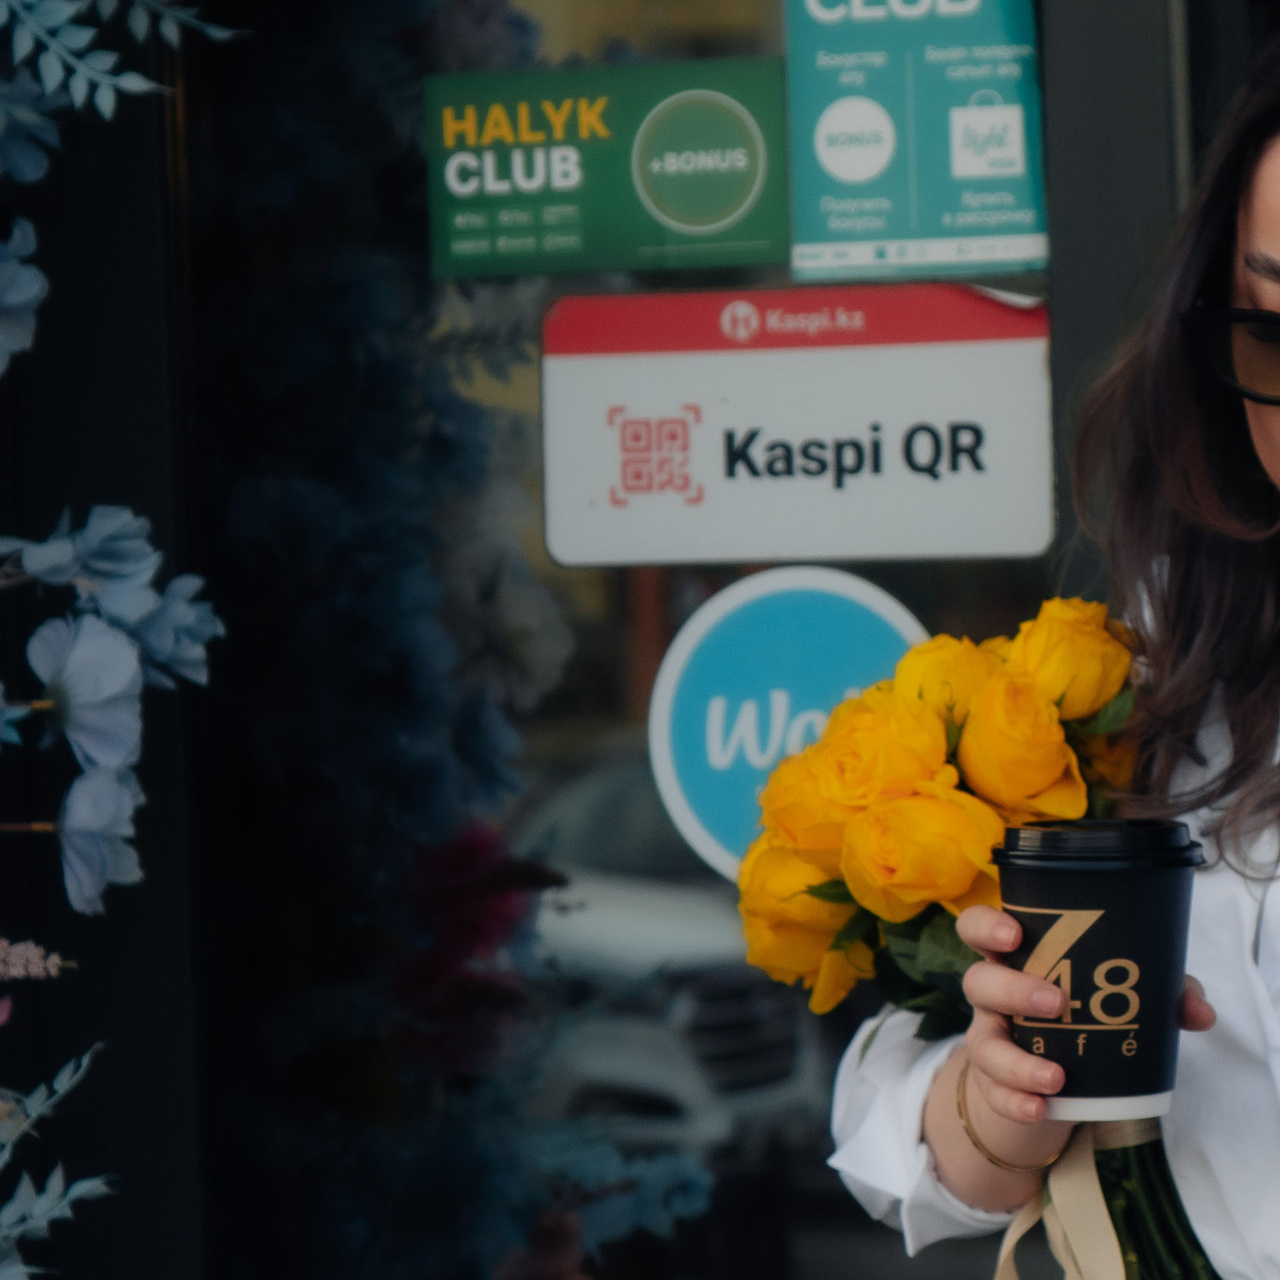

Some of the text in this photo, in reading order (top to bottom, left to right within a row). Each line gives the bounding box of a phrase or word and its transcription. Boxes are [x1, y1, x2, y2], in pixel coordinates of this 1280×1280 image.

[442, 96, 612, 150] HALYK
[444, 144, 583, 197] CLUB
[766, 305, 865, 336] Kaspi.kz
[723, 422, 987, 487] Kaspi QR
